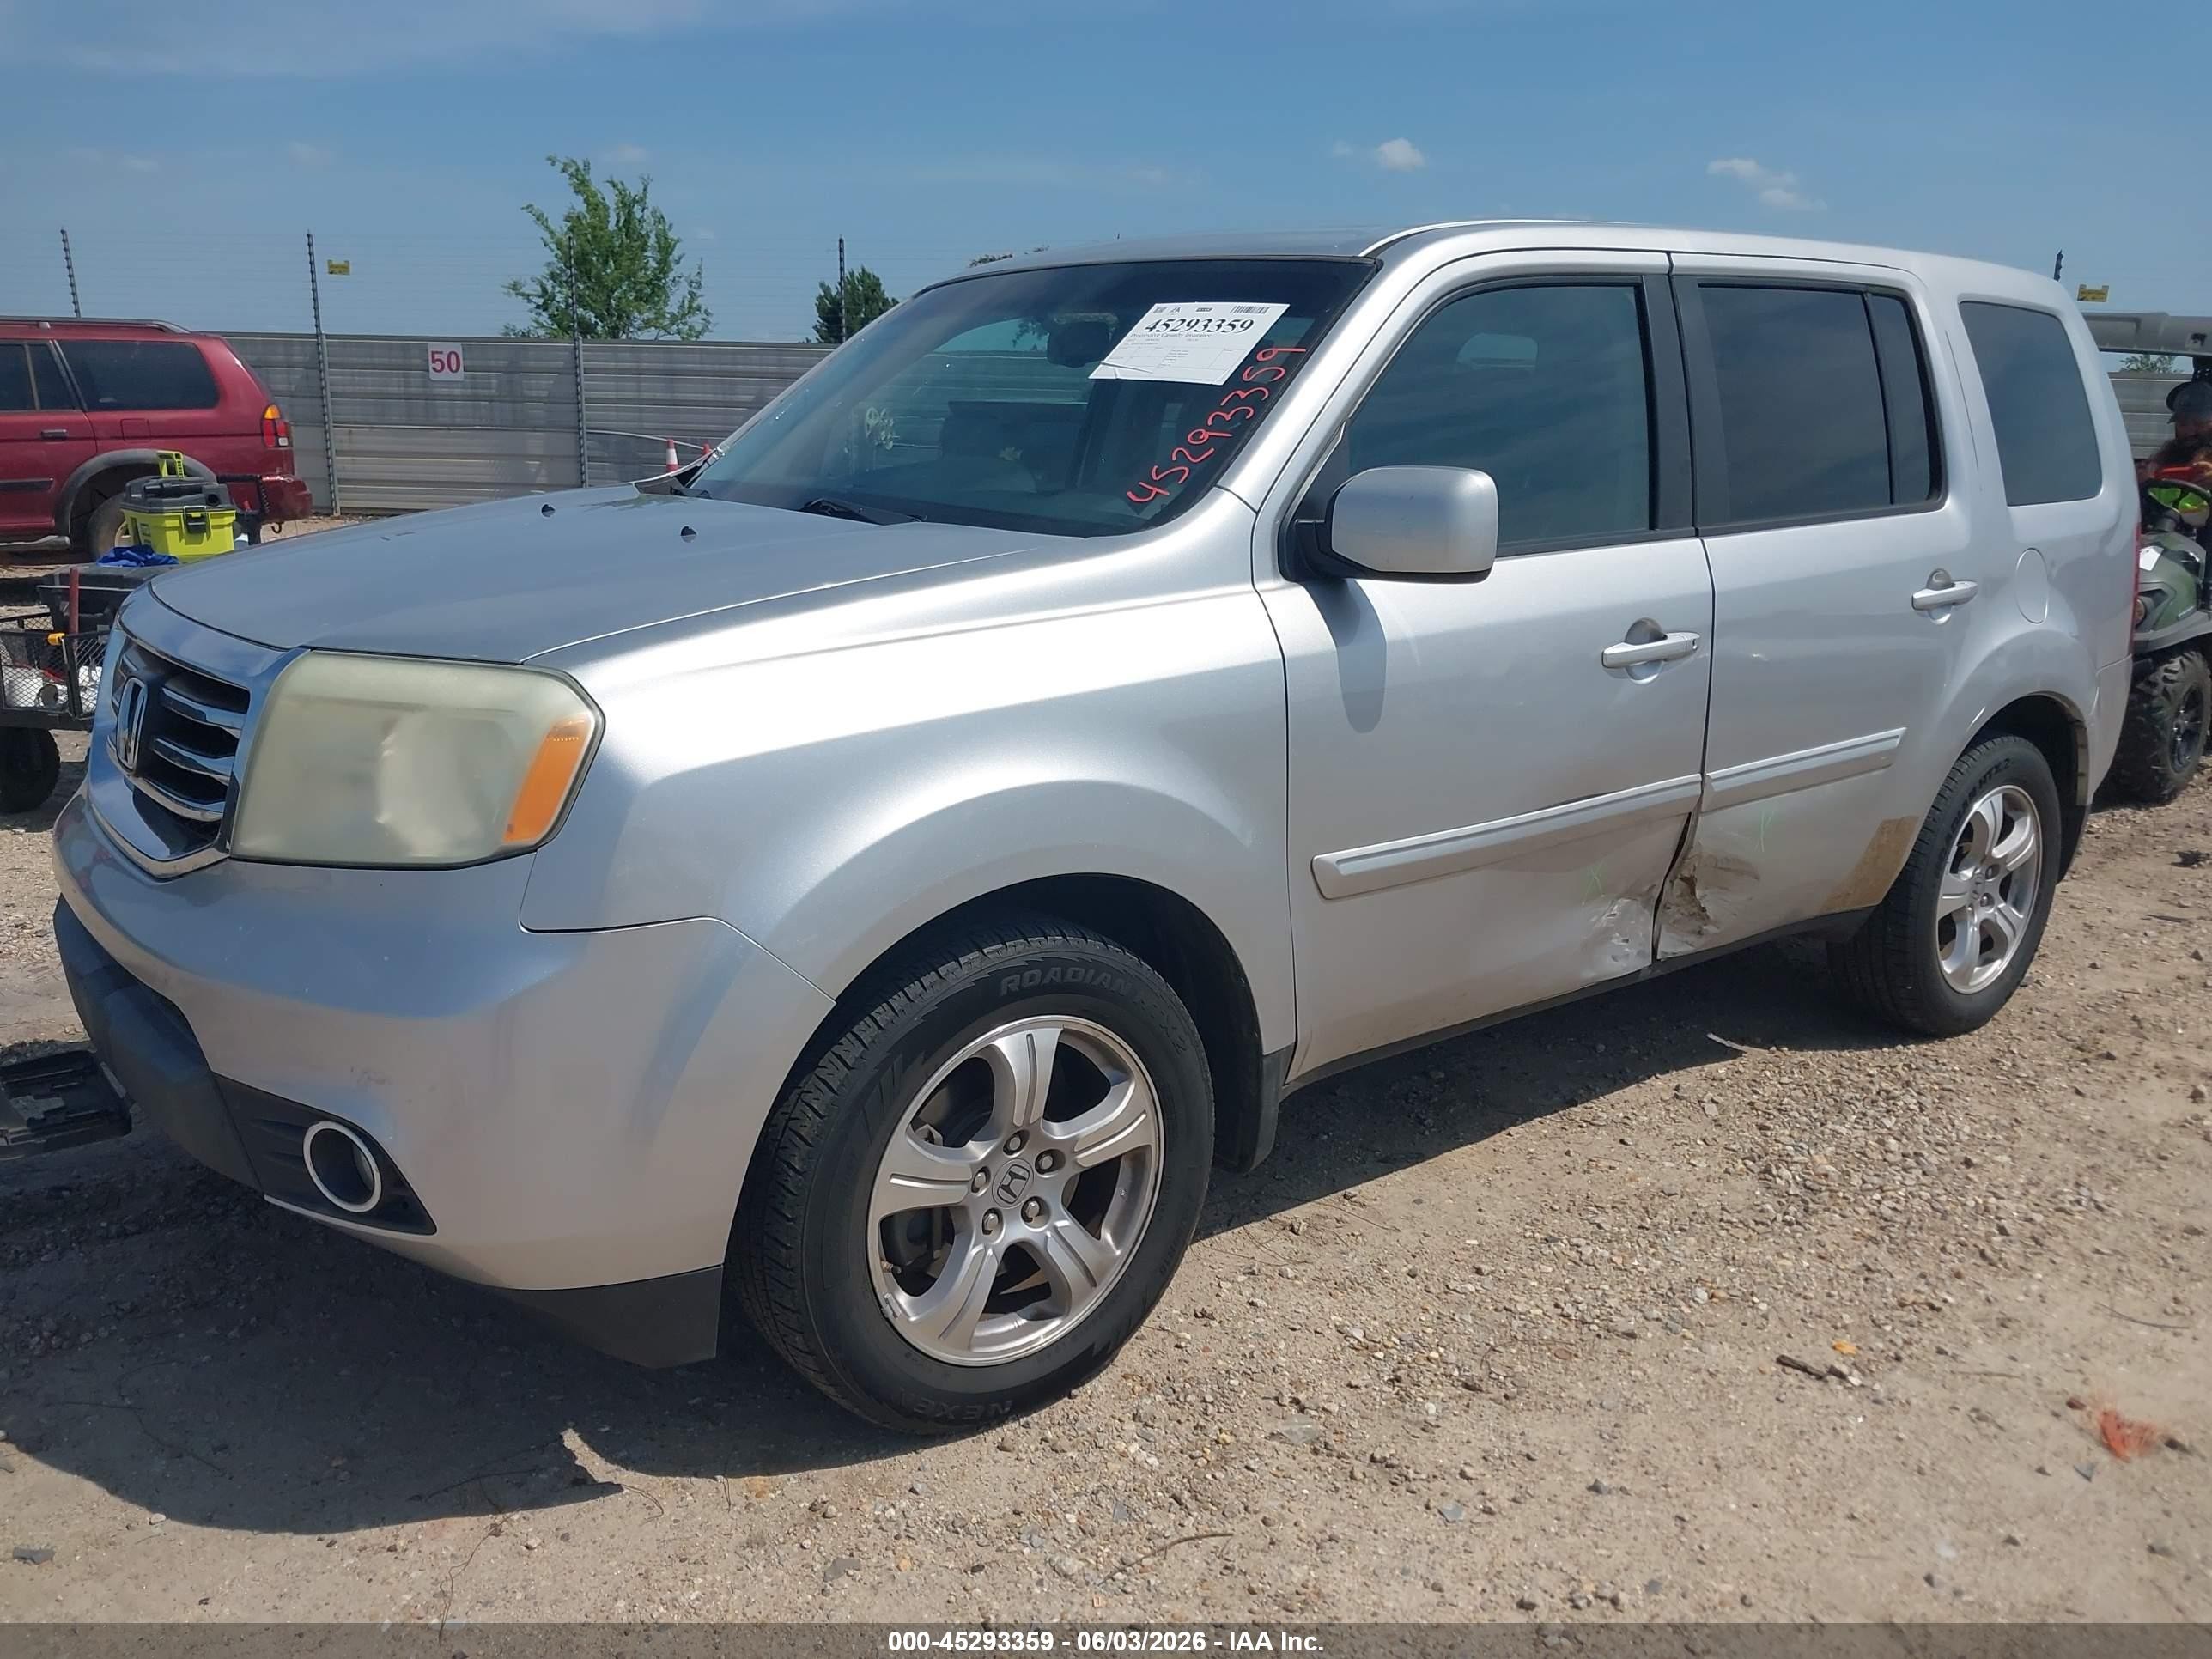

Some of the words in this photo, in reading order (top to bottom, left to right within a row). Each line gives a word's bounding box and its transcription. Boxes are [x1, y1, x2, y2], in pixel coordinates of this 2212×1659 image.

[1145, 319, 1255, 333] 45293359
[431, 350, 461, 374] 50
[1127, 347, 1306, 502] 45293359
[1000, 966, 1135, 997] ROADIAN
